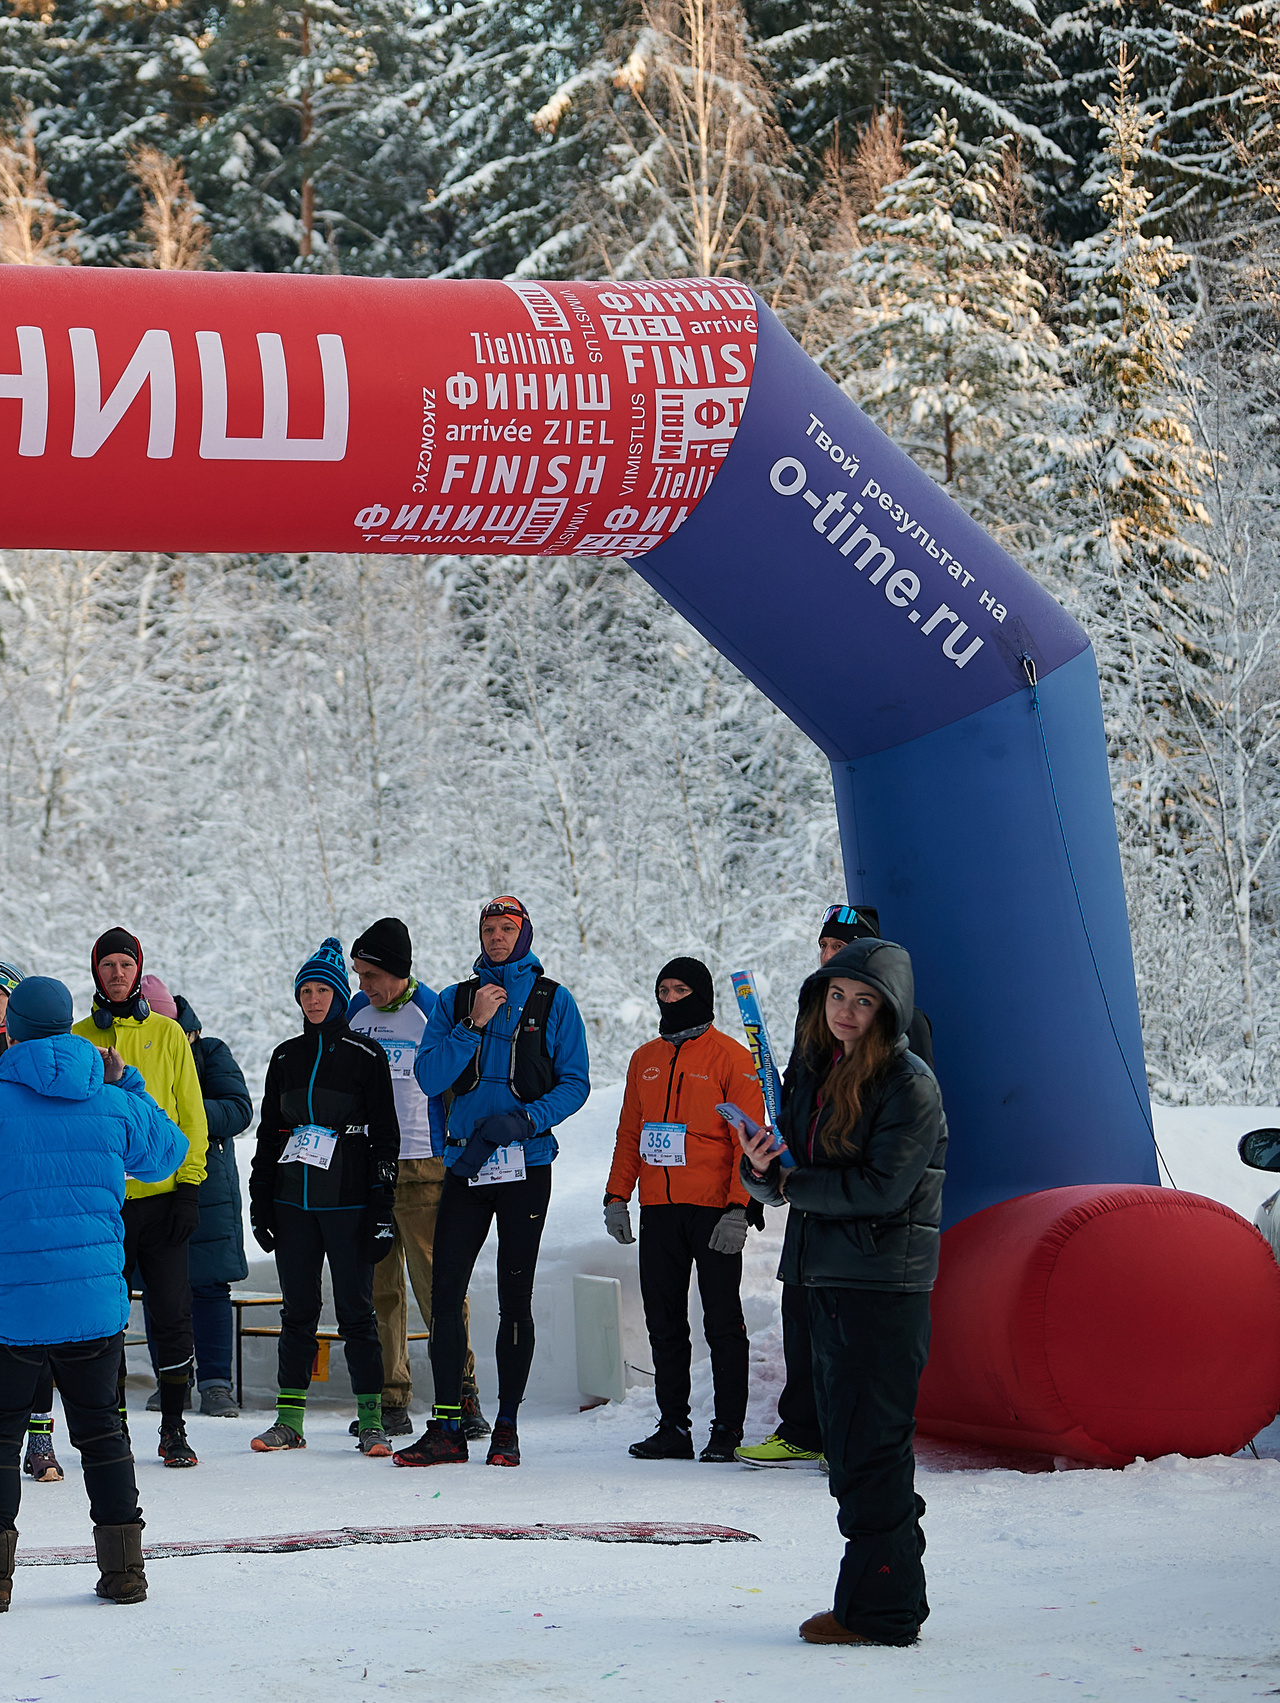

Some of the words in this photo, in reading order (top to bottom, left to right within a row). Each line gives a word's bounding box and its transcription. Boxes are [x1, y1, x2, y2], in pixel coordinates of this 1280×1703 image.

[560, 289, 603, 363] VIIMISTLUS
[606, 317, 682, 337] ZIEL
[690, 314, 758, 335] arrivé
[470, 332, 575, 365] Ziellinie
[445, 371, 611, 411] ФИНИШ
[412, 387, 437, 494] ZAKOŃCZYĆ
[445, 418, 532, 442] arrivée
[543, 420, 614, 445] ZIEL
[658, 394, 684, 460] MAALI
[619, 393, 646, 497] VIIMISTLUS
[440, 455, 606, 495] FINISH
[354, 503, 527, 531] ФИНИШ
[805, 413, 861, 479] Твой
[861, 478, 976, 588] результат
[978, 590, 1008, 623] на
[362, 534, 510, 543] TERMINAR
[581, 534, 658, 549] ZIEL
[294, 1132, 320, 1150] 351
[647, 1132, 671, 1149] 356
[482, 1149, 508, 1167] 41
